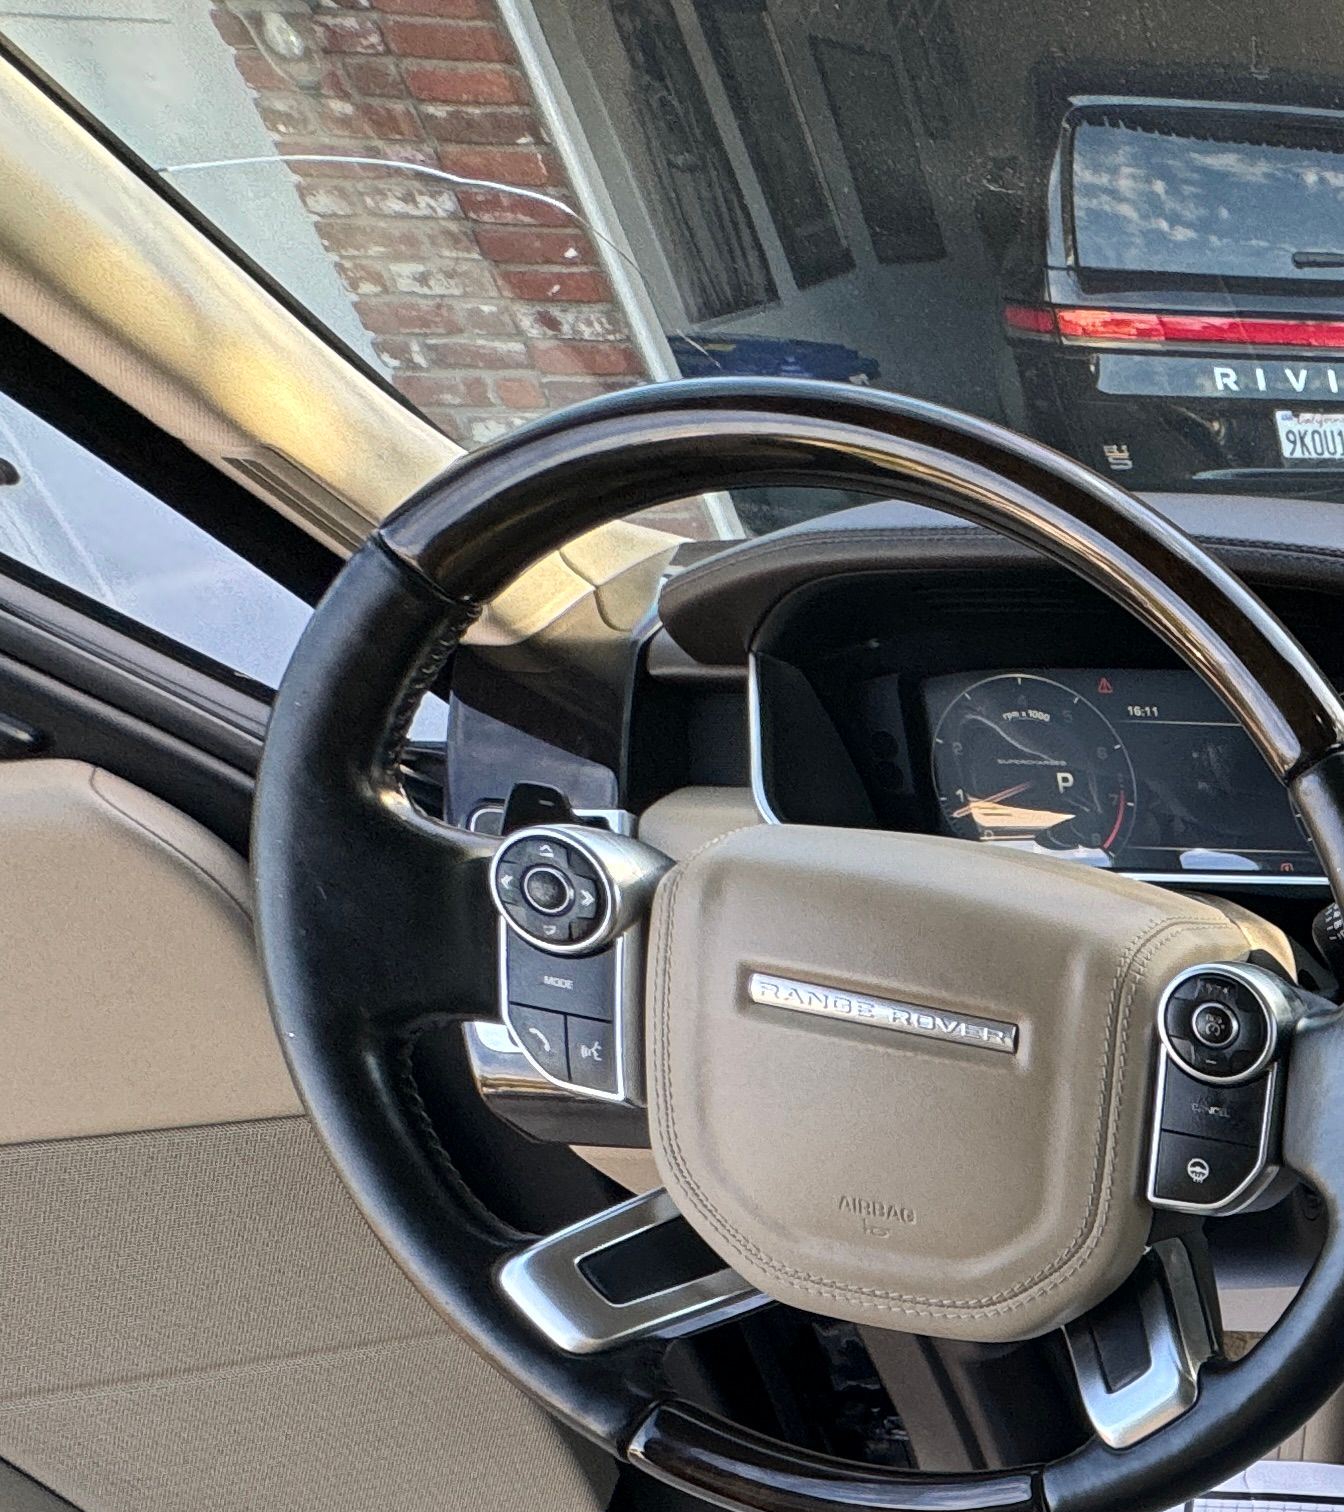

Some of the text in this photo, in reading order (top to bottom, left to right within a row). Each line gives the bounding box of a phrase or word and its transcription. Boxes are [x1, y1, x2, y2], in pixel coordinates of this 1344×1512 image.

[1028, 709, 1050, 722] 1000
[1127, 705, 1159, 717] 16:11
[1056, 772, 1075, 794] P
[543, 975, 574, 990] MODE
[759, 980, 1008, 1045] RANGE ROVER
[838, 1195, 918, 1226] AIRBAG
